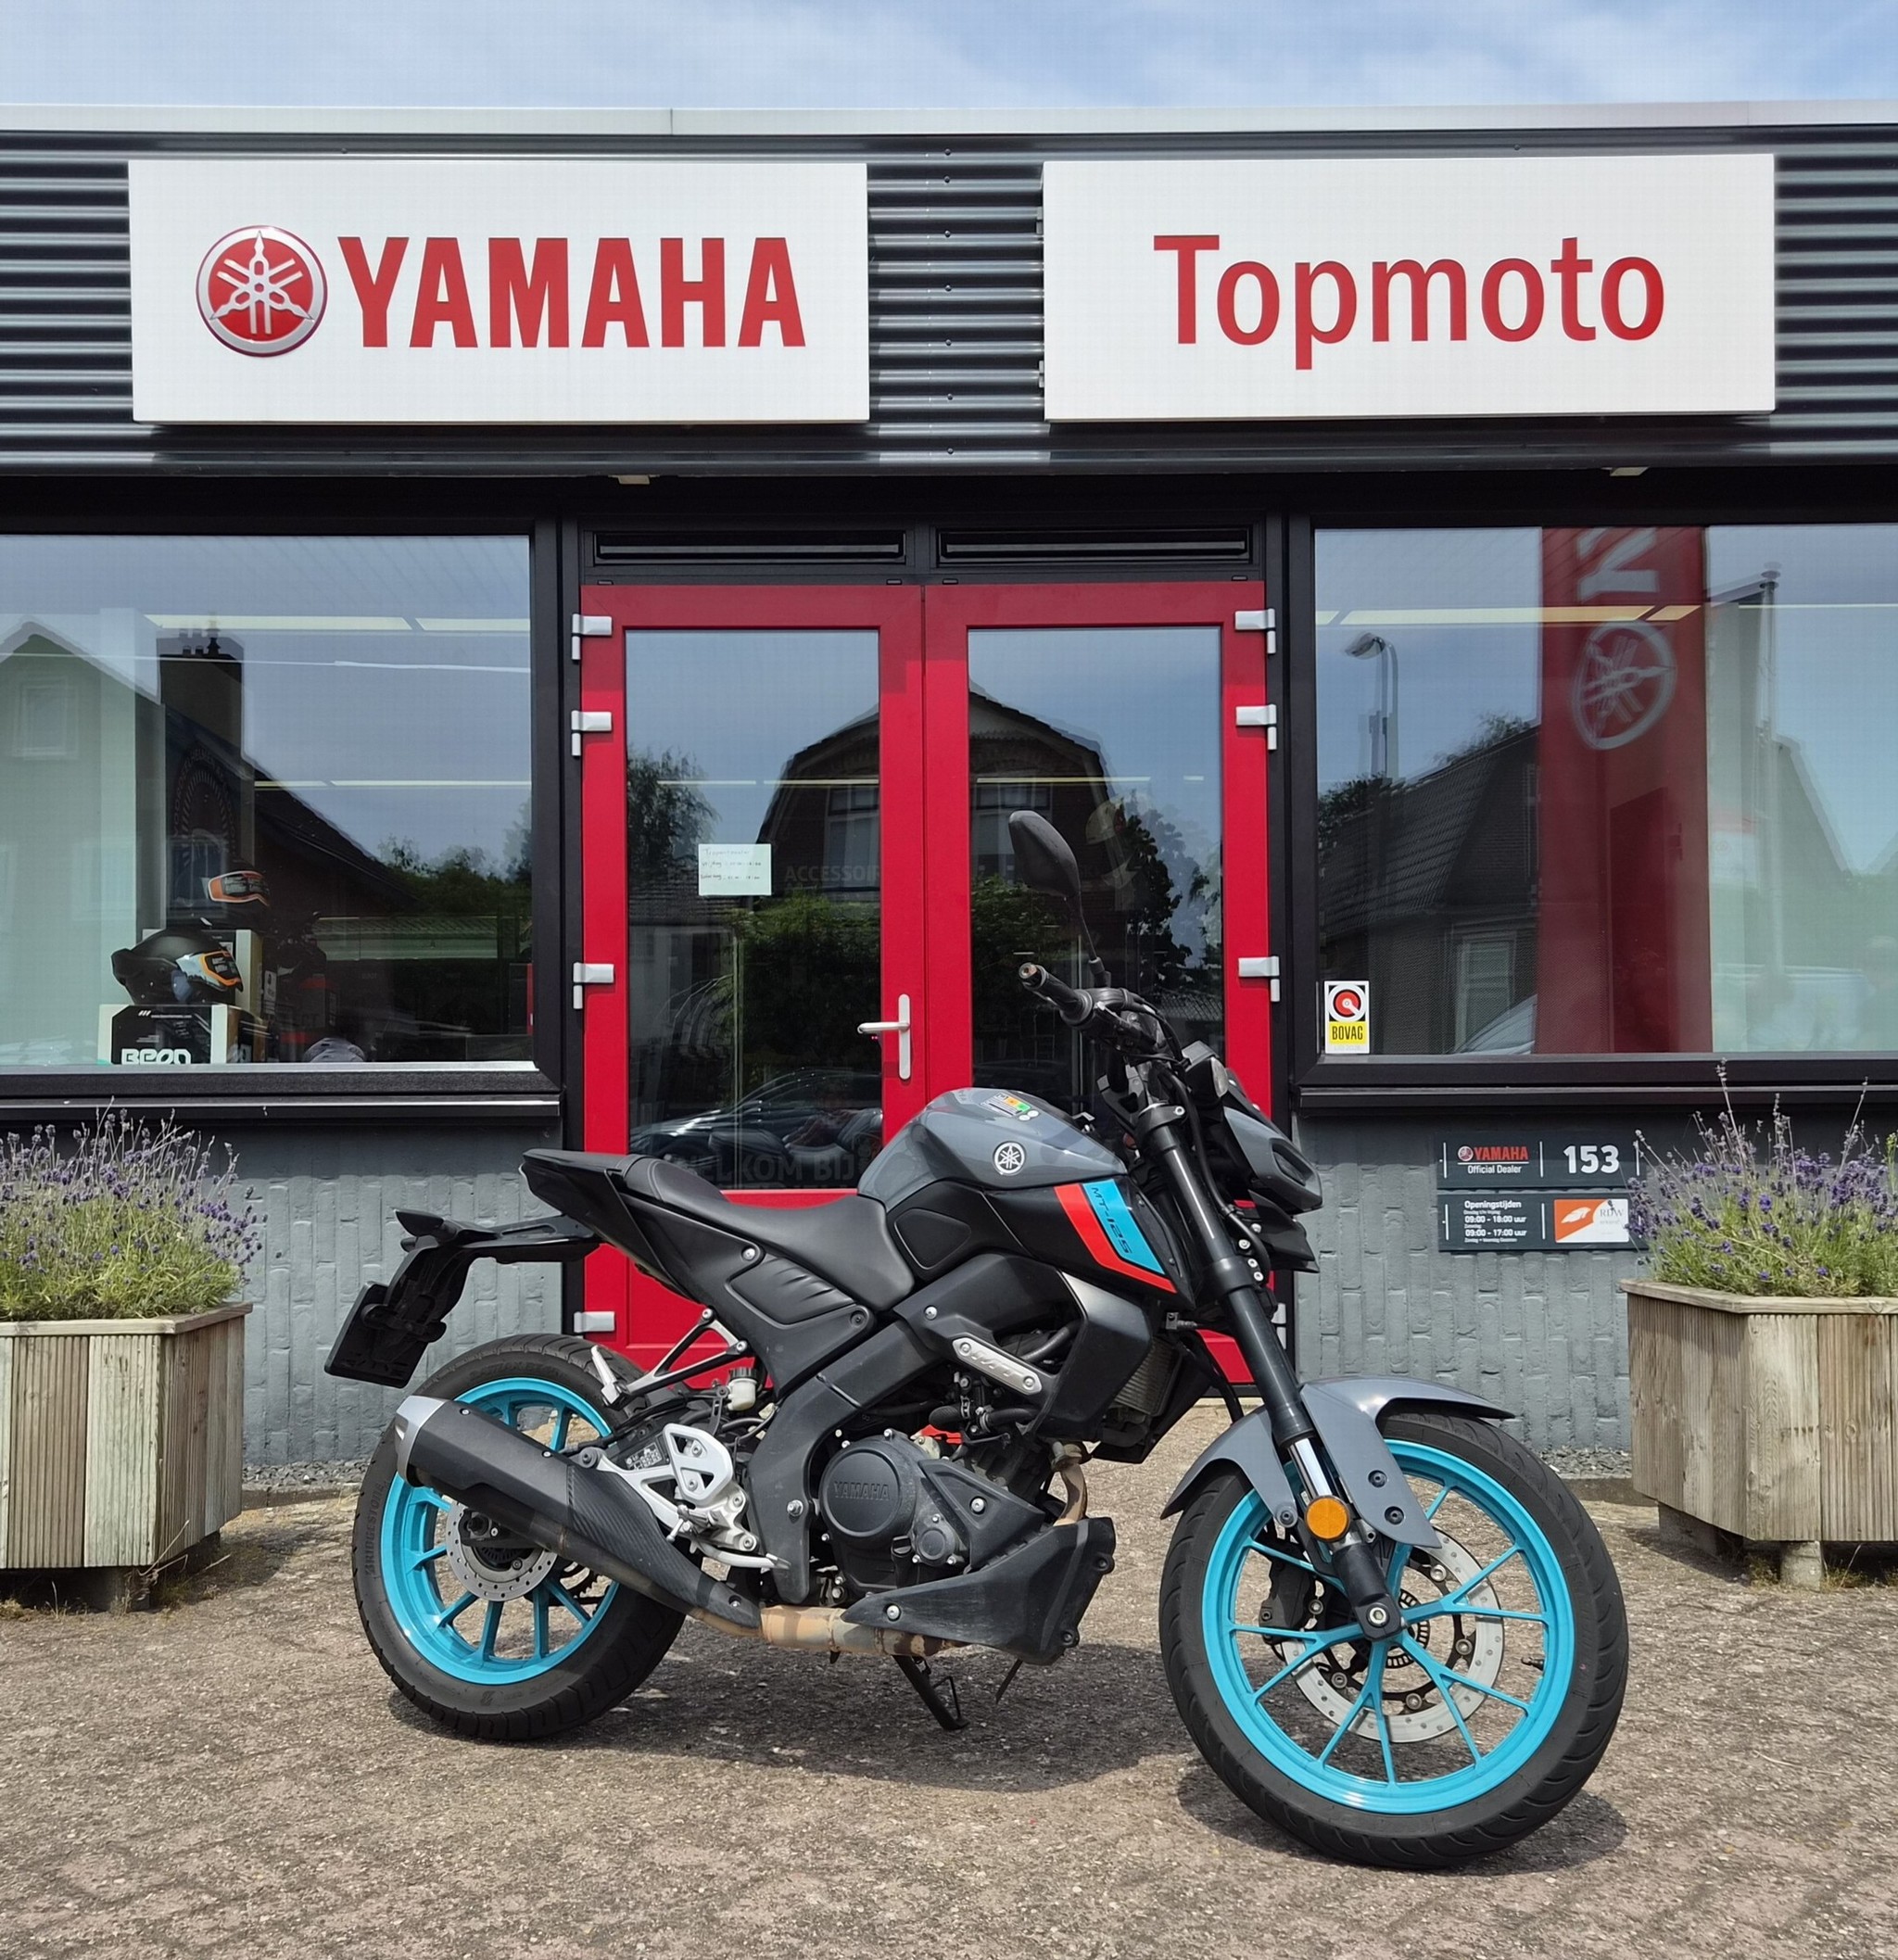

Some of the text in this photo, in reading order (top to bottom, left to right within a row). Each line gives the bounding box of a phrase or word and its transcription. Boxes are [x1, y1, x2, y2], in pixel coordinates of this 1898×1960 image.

[337, 236, 806, 348] YAMAHA
[1153, 234, 1664, 371] Topmoto
[1332, 1025, 1363, 1041] BOVAG
[1474, 1146, 1529, 1161] YAMAHA
[1563, 1144, 1620, 1174] 153
[697, 1154, 803, 1182] ELKOM
[1467, 1164, 1522, 1174] Official Dealer
[1464, 1200, 1522, 1210] Openingstijden
[1464, 1215, 1486, 1223] 09:00
[1493, 1215, 1513, 1223] 18:00
[1465, 1229, 1487, 1237] 09:00
[1493, 1229, 1513, 1237] 17:00
[835, 1482, 890, 1501] YAMAHA
[365, 1484, 384, 1575] BRIDGESTONE
